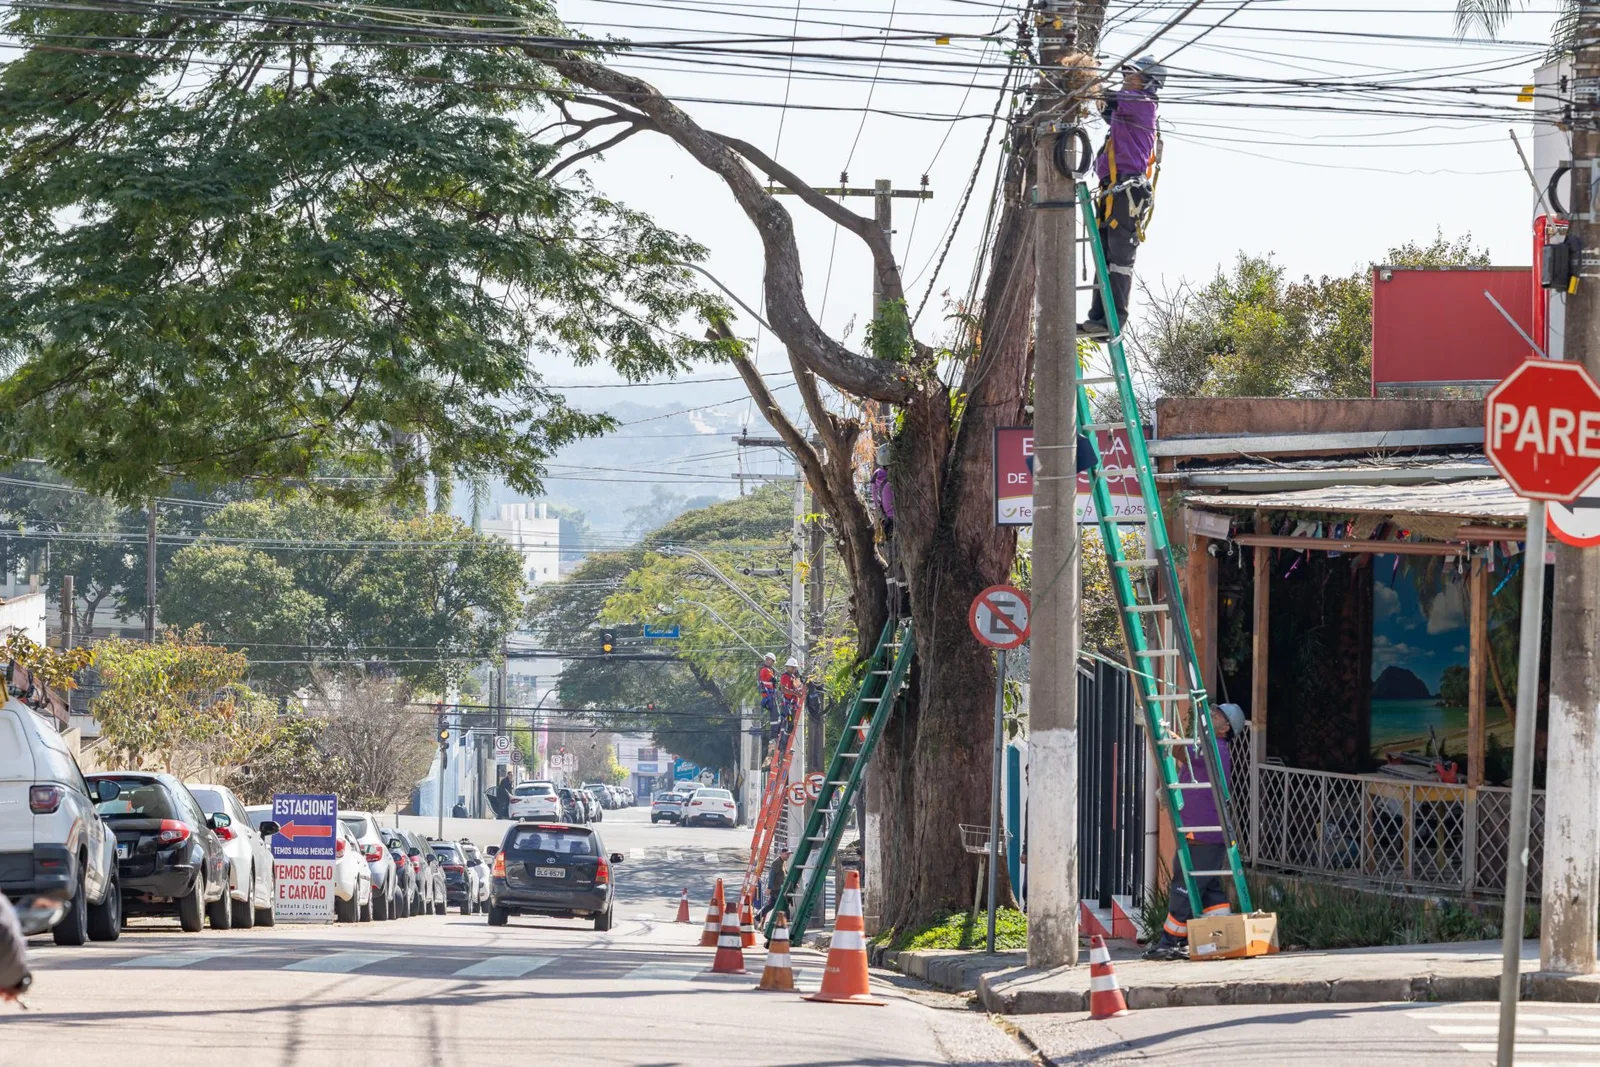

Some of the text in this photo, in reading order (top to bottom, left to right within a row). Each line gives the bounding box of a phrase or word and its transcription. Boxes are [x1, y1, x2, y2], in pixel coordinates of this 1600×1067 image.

[1493, 402, 1600, 459] PARE
[1007, 473, 1028, 484] DE
[275, 799, 334, 816] ESTACIONE
[274, 847, 334, 856] TEMOS VAGAS MENSAIS
[275, 865, 333, 880] TEMOS GELO
[280, 881, 326, 900] E CARVÃO
